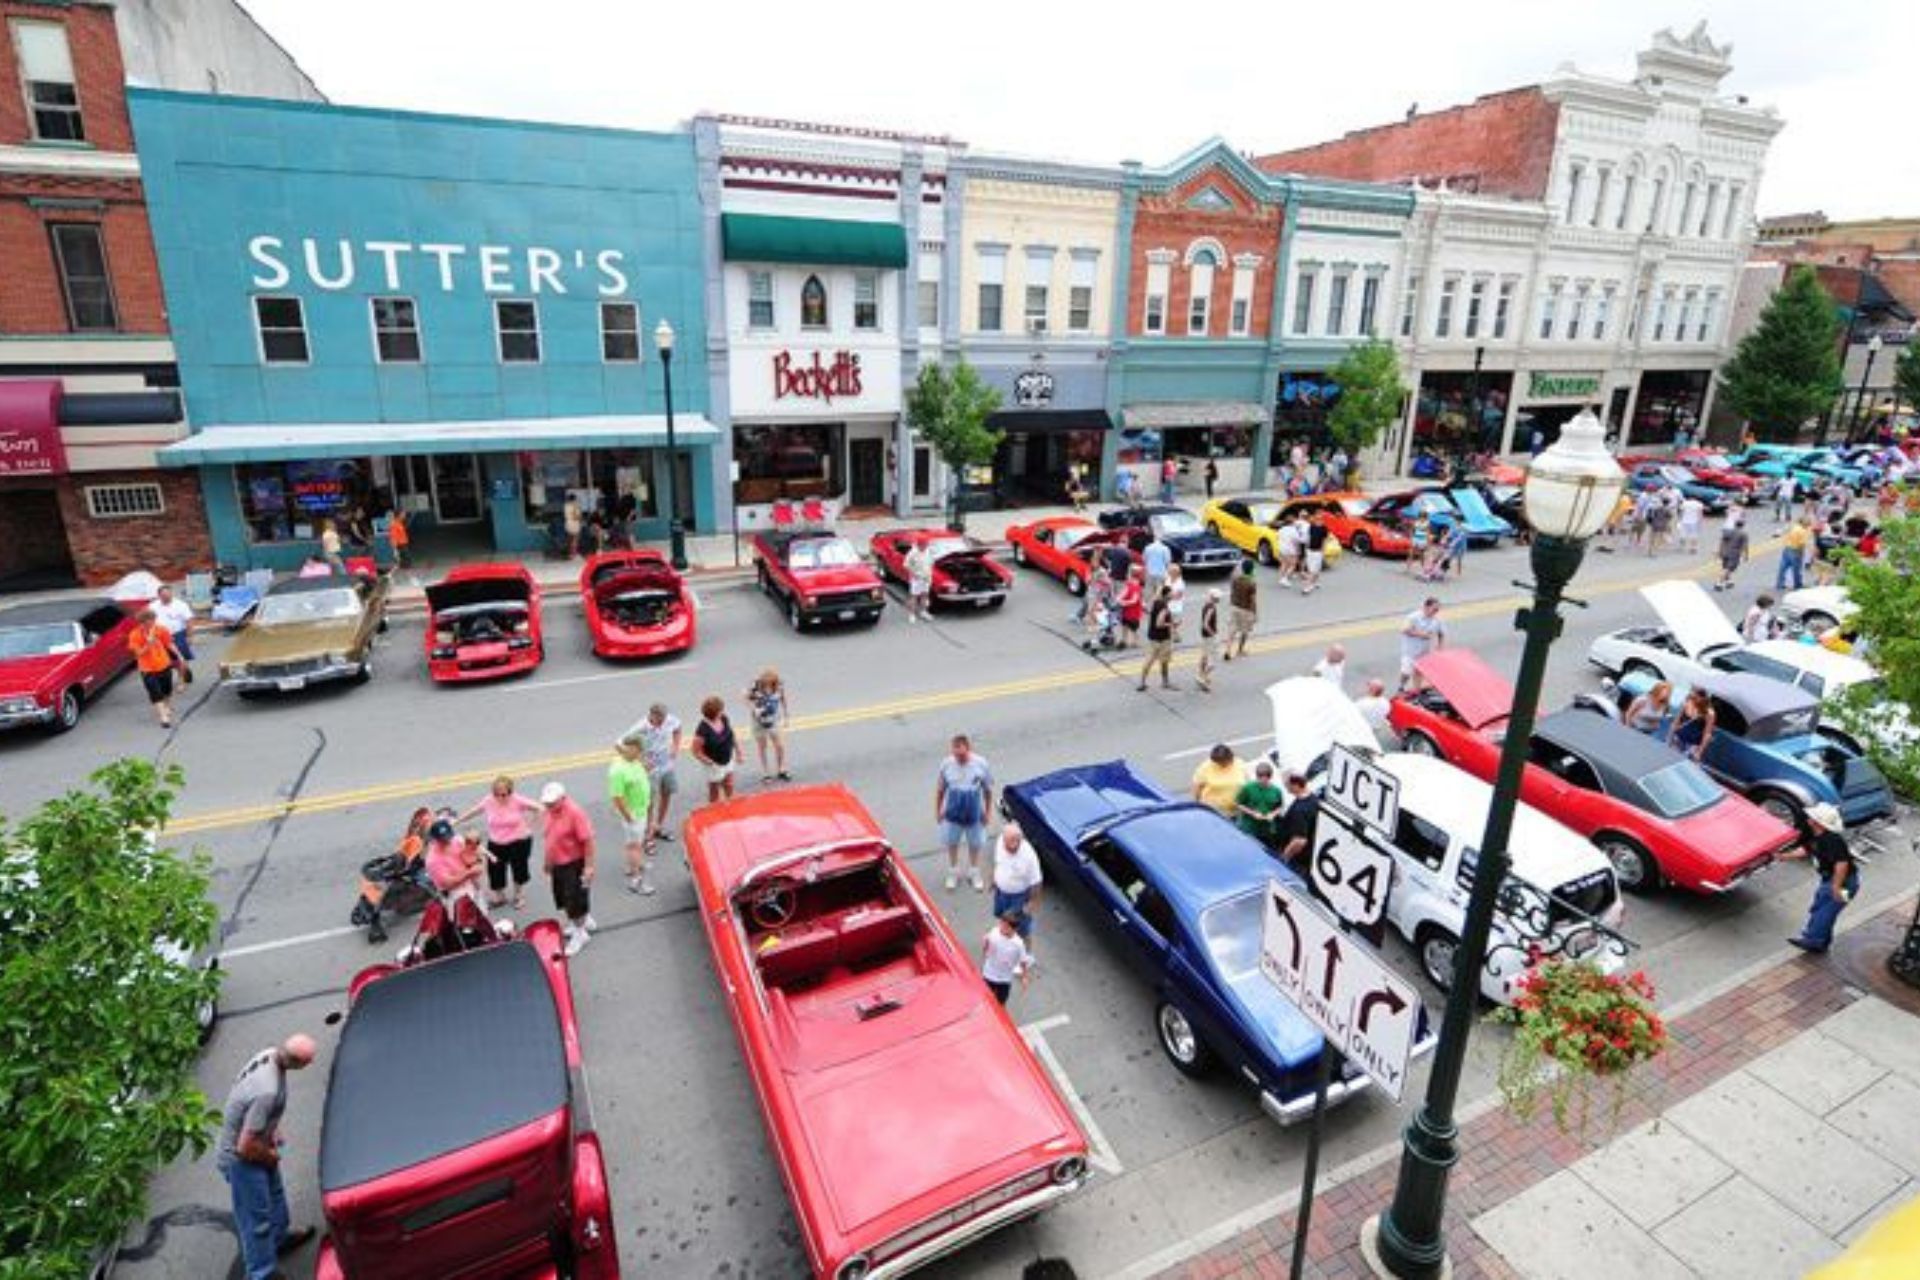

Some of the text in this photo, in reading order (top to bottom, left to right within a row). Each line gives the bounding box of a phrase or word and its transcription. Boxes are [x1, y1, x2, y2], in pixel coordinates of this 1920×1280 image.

[248, 235, 629, 296] SUTTER'S
[1332, 759, 1393, 822] JCT
[1317, 837, 1378, 914] 64
[1263, 950, 1399, 1083] ONLY ONLY ONLY
